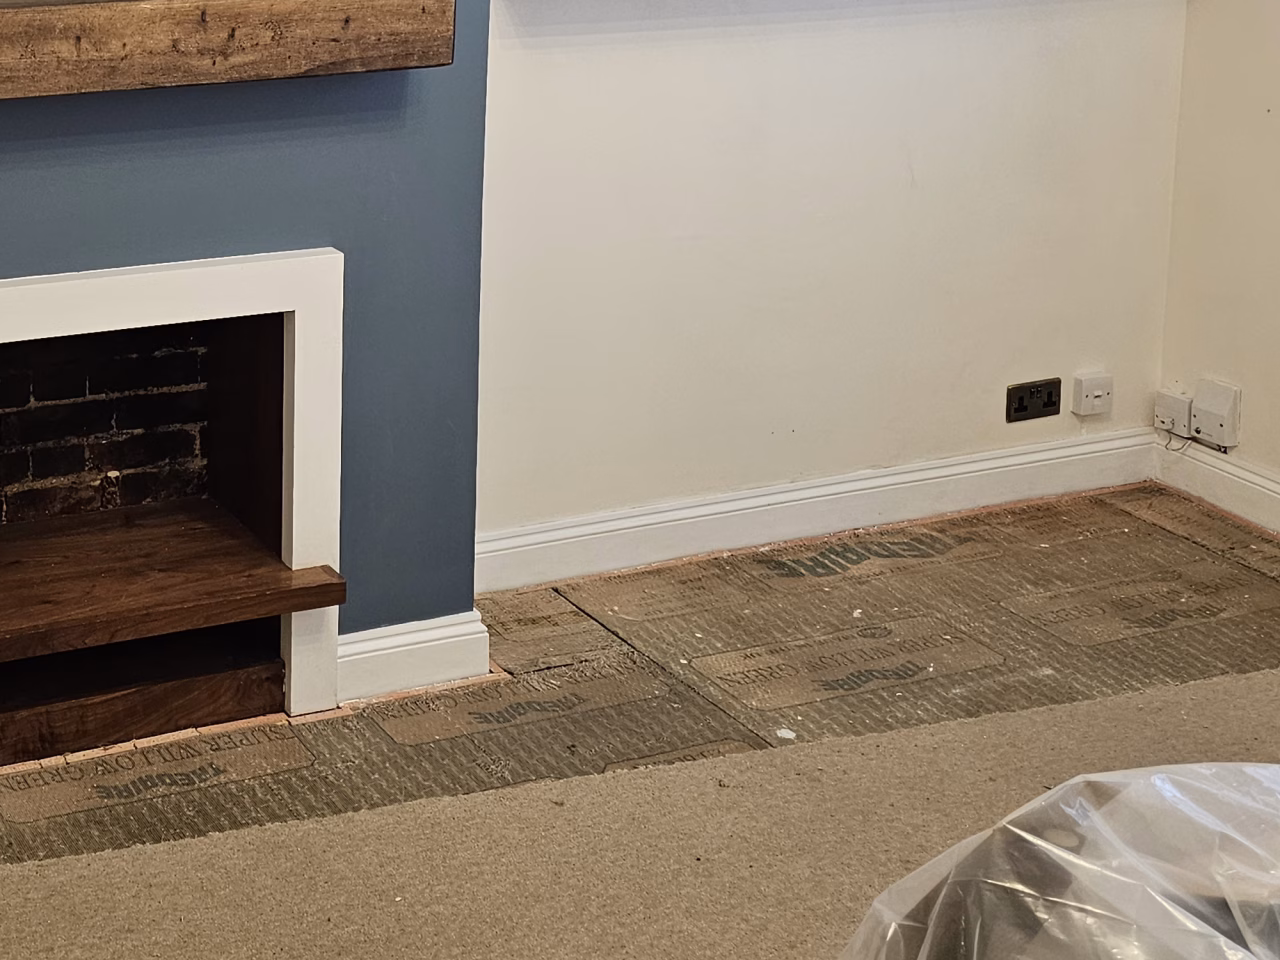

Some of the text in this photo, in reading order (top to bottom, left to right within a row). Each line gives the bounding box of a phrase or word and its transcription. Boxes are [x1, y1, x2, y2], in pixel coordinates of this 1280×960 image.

[715, 664, 799, 687] GREEN
[467, 694, 590, 726] TREDAIRE
[205, 726, 287, 753] SUPER
[90, 743, 203, 775] WILLOW
[93, 762, 229, 801] TREDAIRE
